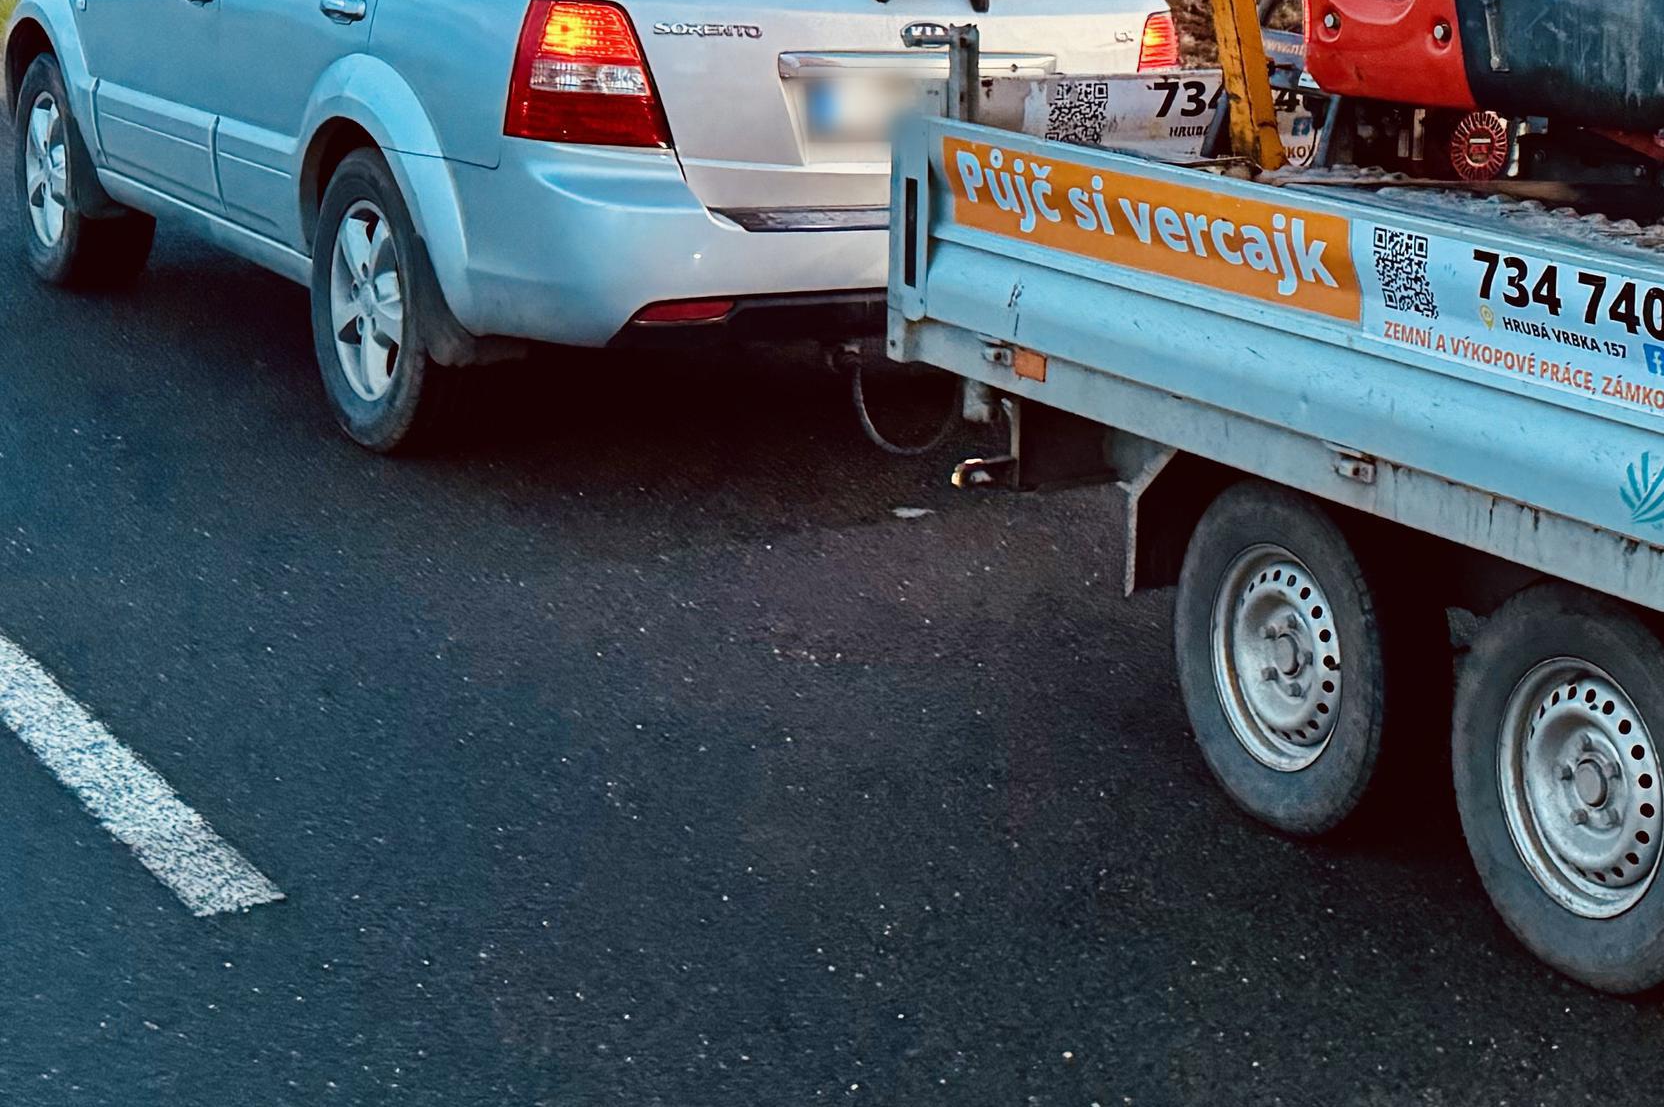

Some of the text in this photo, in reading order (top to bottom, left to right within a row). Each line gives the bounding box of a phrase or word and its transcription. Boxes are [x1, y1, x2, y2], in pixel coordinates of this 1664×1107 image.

[653, 22, 763, 39] SORENTO
[956, 147, 1339, 296] Půjč si vercajk
[1473, 248, 1562, 316] 734
[1384, 320, 1433, 349] ZEMNÍ
[1435, 334, 1447, 353] A
[1450, 336, 1535, 376] VÝKOPOVÉ
[1539, 361, 1596, 395] PRÁCE,
[1502, 317, 1627, 359] HRUBÁ VRBKA 157
